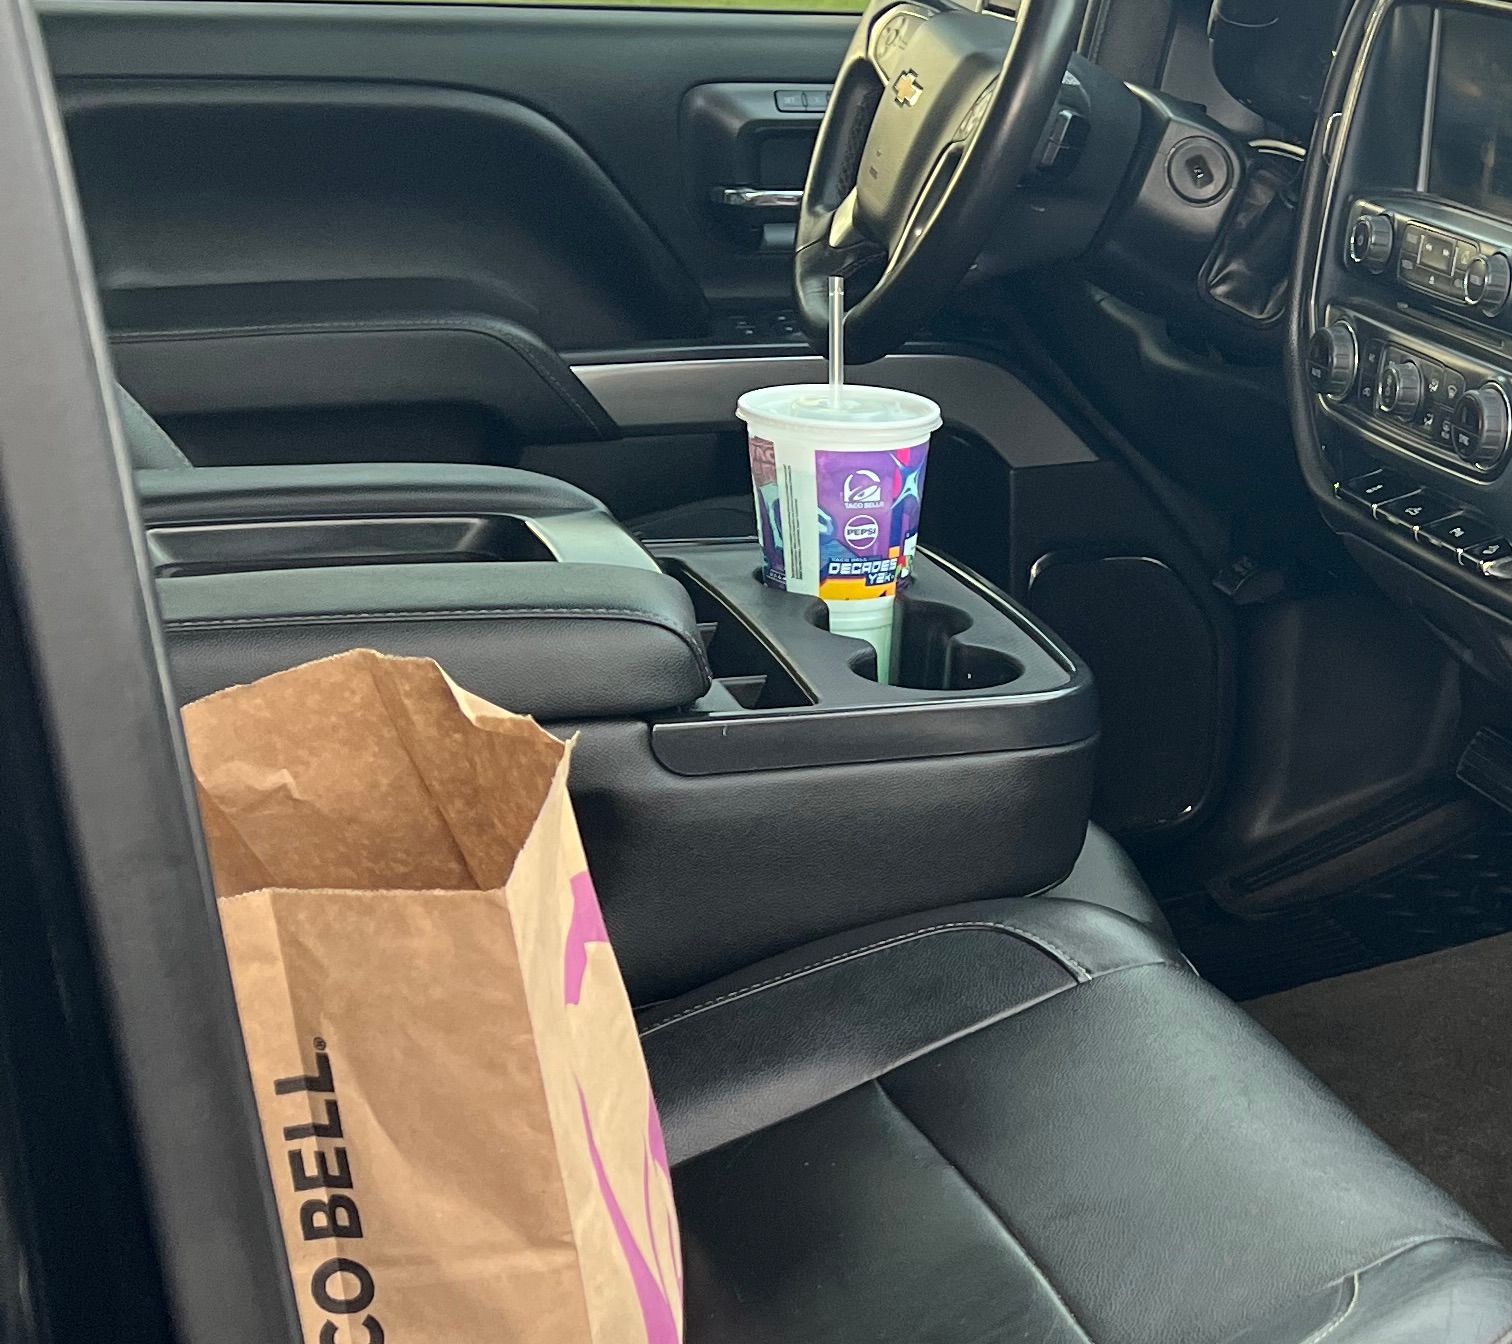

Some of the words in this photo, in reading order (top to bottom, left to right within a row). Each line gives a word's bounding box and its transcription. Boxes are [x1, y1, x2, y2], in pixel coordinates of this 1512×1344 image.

[846, 528, 876, 536] PEPSI
[828, 558, 897, 575] DECADES
[274, 1051, 363, 1241] BELL
